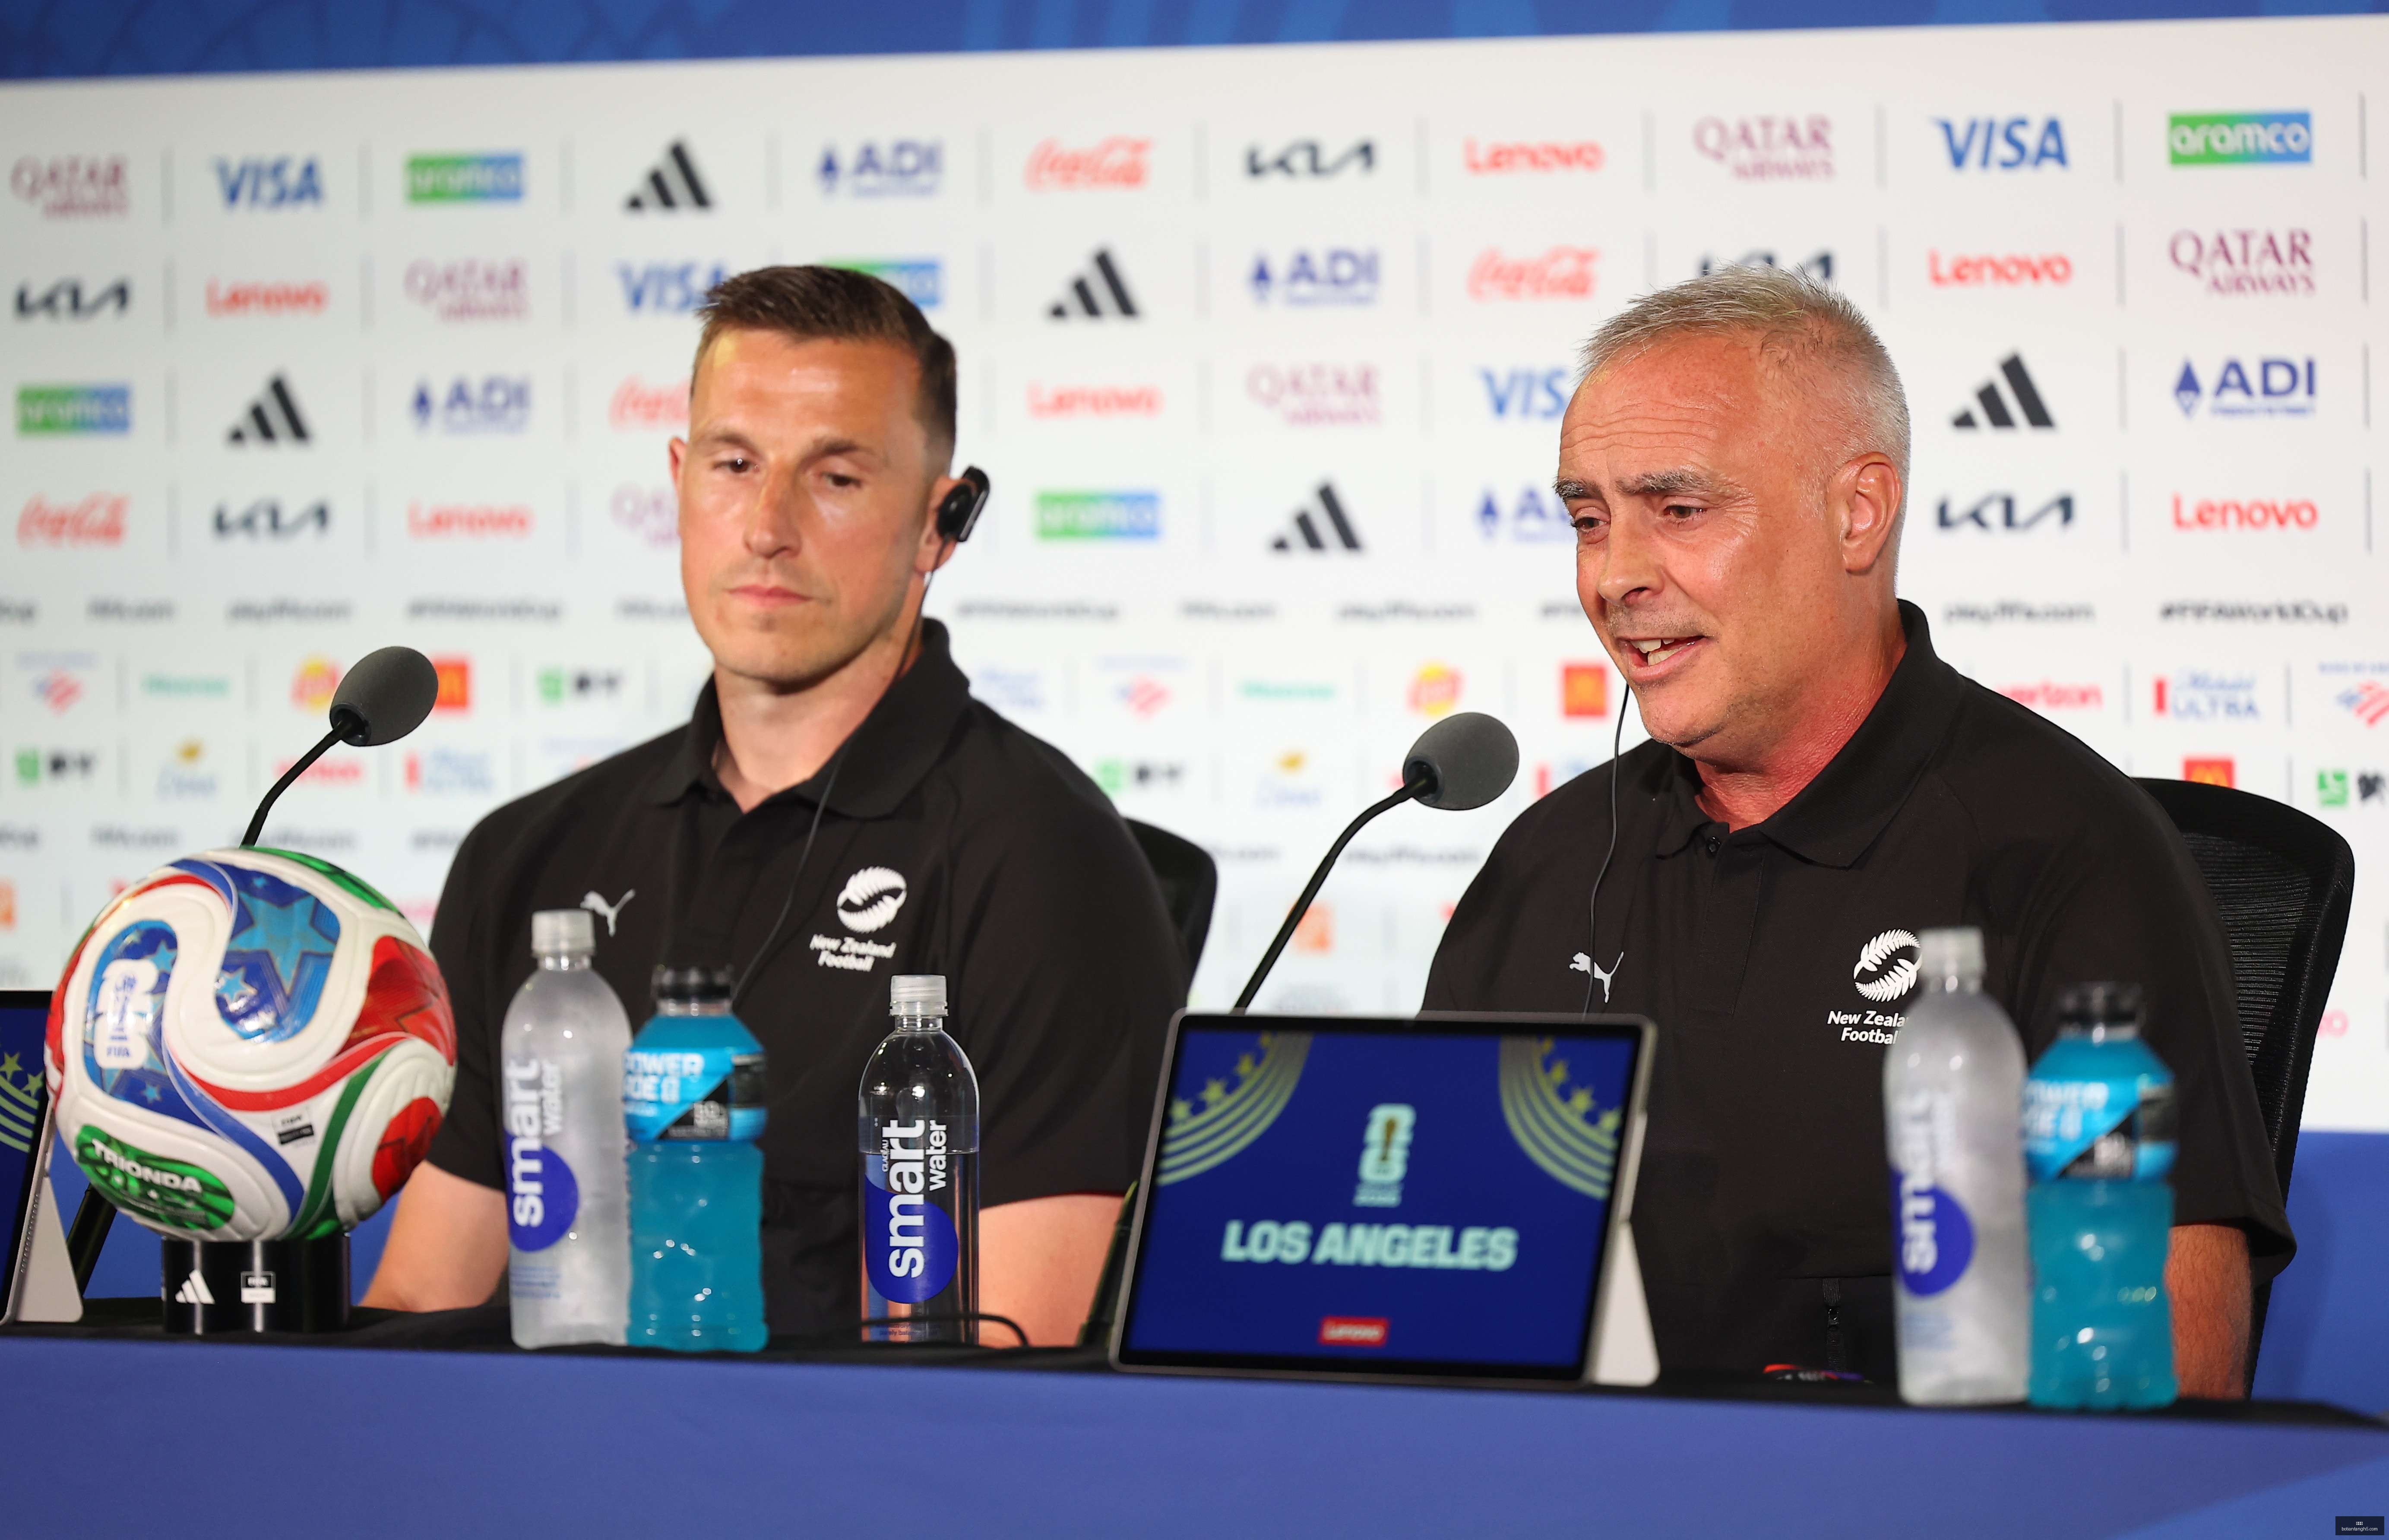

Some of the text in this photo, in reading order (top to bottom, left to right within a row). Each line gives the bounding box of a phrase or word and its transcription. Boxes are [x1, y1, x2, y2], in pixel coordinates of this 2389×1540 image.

[1465, 139, 1604, 174] Lenovo
[1693, 116, 1832, 160] QATAR
[1933, 116, 2069, 170] VISA
[2172, 122, 2310, 155] aramco
[214, 156, 324, 209] VISA
[1929, 250, 2073, 287] Lenovo
[2169, 229, 2312, 276] QATAR
[1480, 368, 1568, 418] VIS
[2213, 357, 2316, 398] ADI
[2172, 494, 2319, 530] Lenovo
[2173, 697, 2259, 718] ULTRA
[817, 950, 875, 972] Football
[1827, 1010, 1909, 1028] New Zeala
[91, 1138, 203, 1193] TRIONDA
[508, 1058, 545, 1228] smart
[925, 1119, 947, 1192] water
[882, 1119, 925, 1278] smart
[1221, 1219, 1520, 1272] LOS ANGELES
